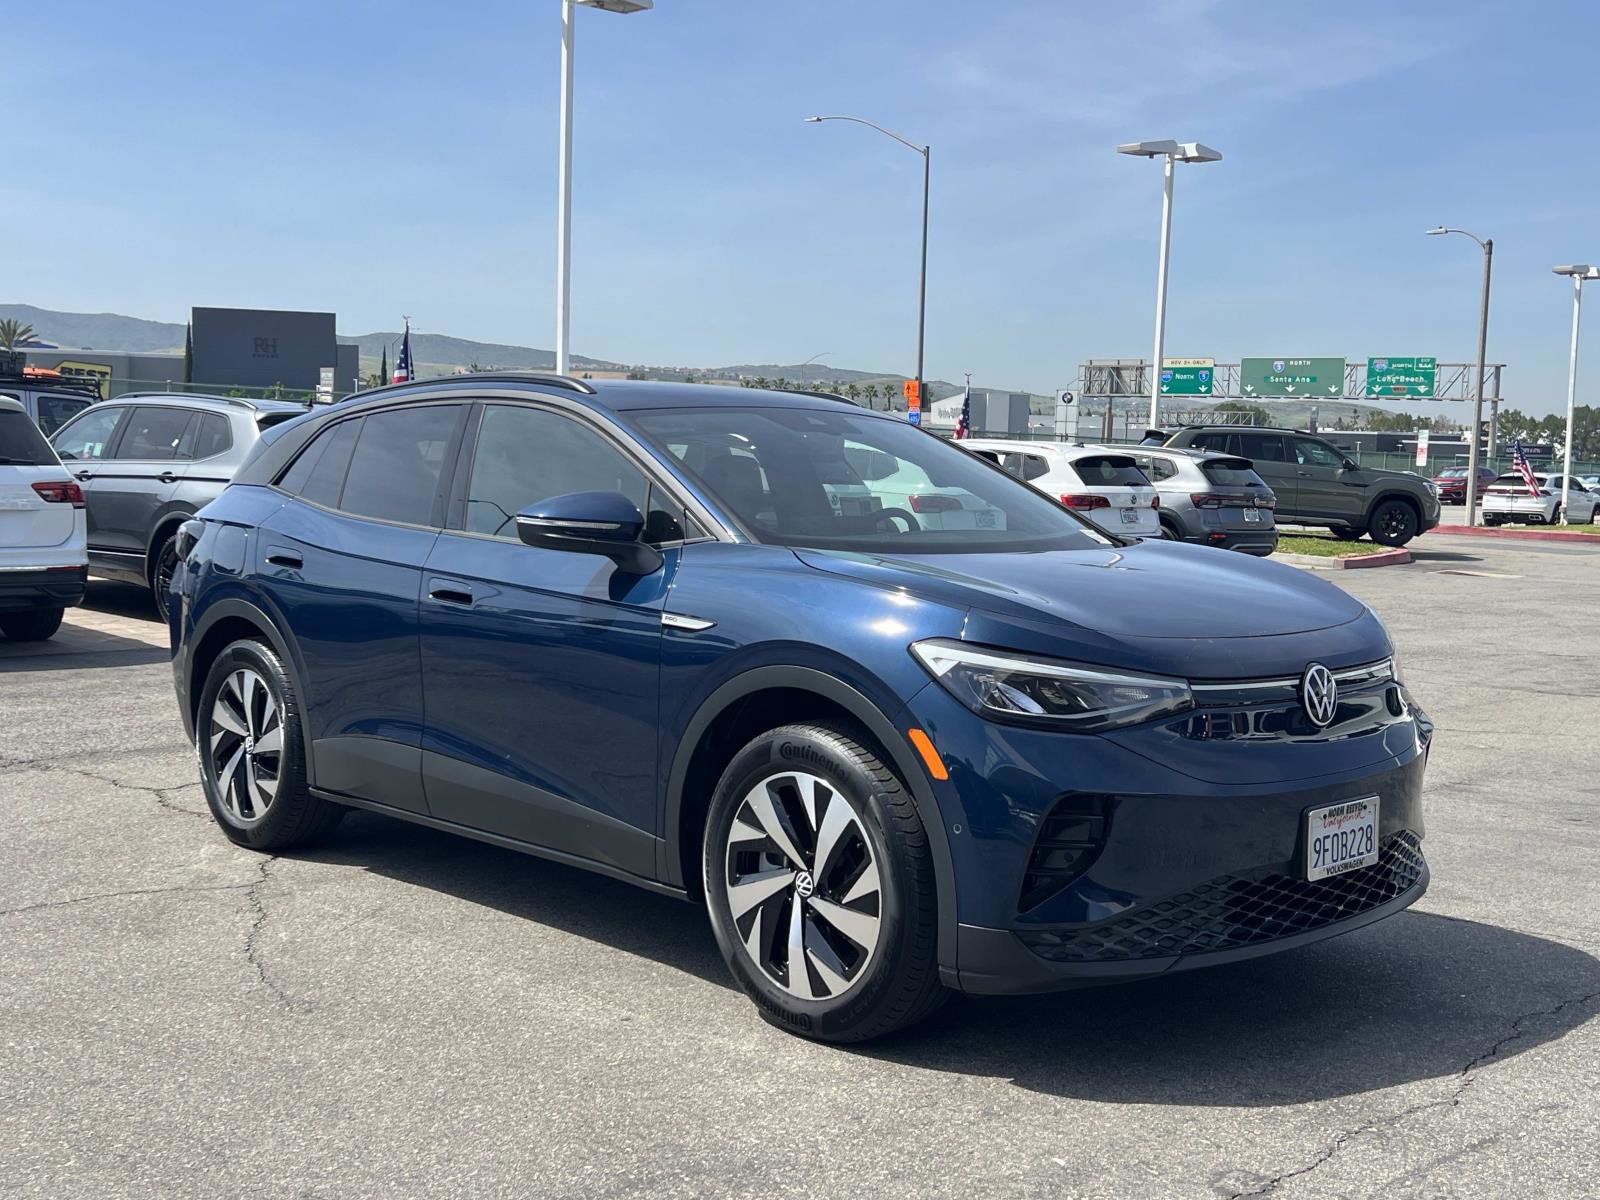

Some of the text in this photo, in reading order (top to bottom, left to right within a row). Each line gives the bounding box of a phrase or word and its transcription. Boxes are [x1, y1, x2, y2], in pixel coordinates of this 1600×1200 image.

[254, 337, 278, 353] RH
[1376, 376, 1397, 384] Long
[780, 741, 850, 783] Continental
[1326, 858, 1364, 875] VOLKSWAGEN
